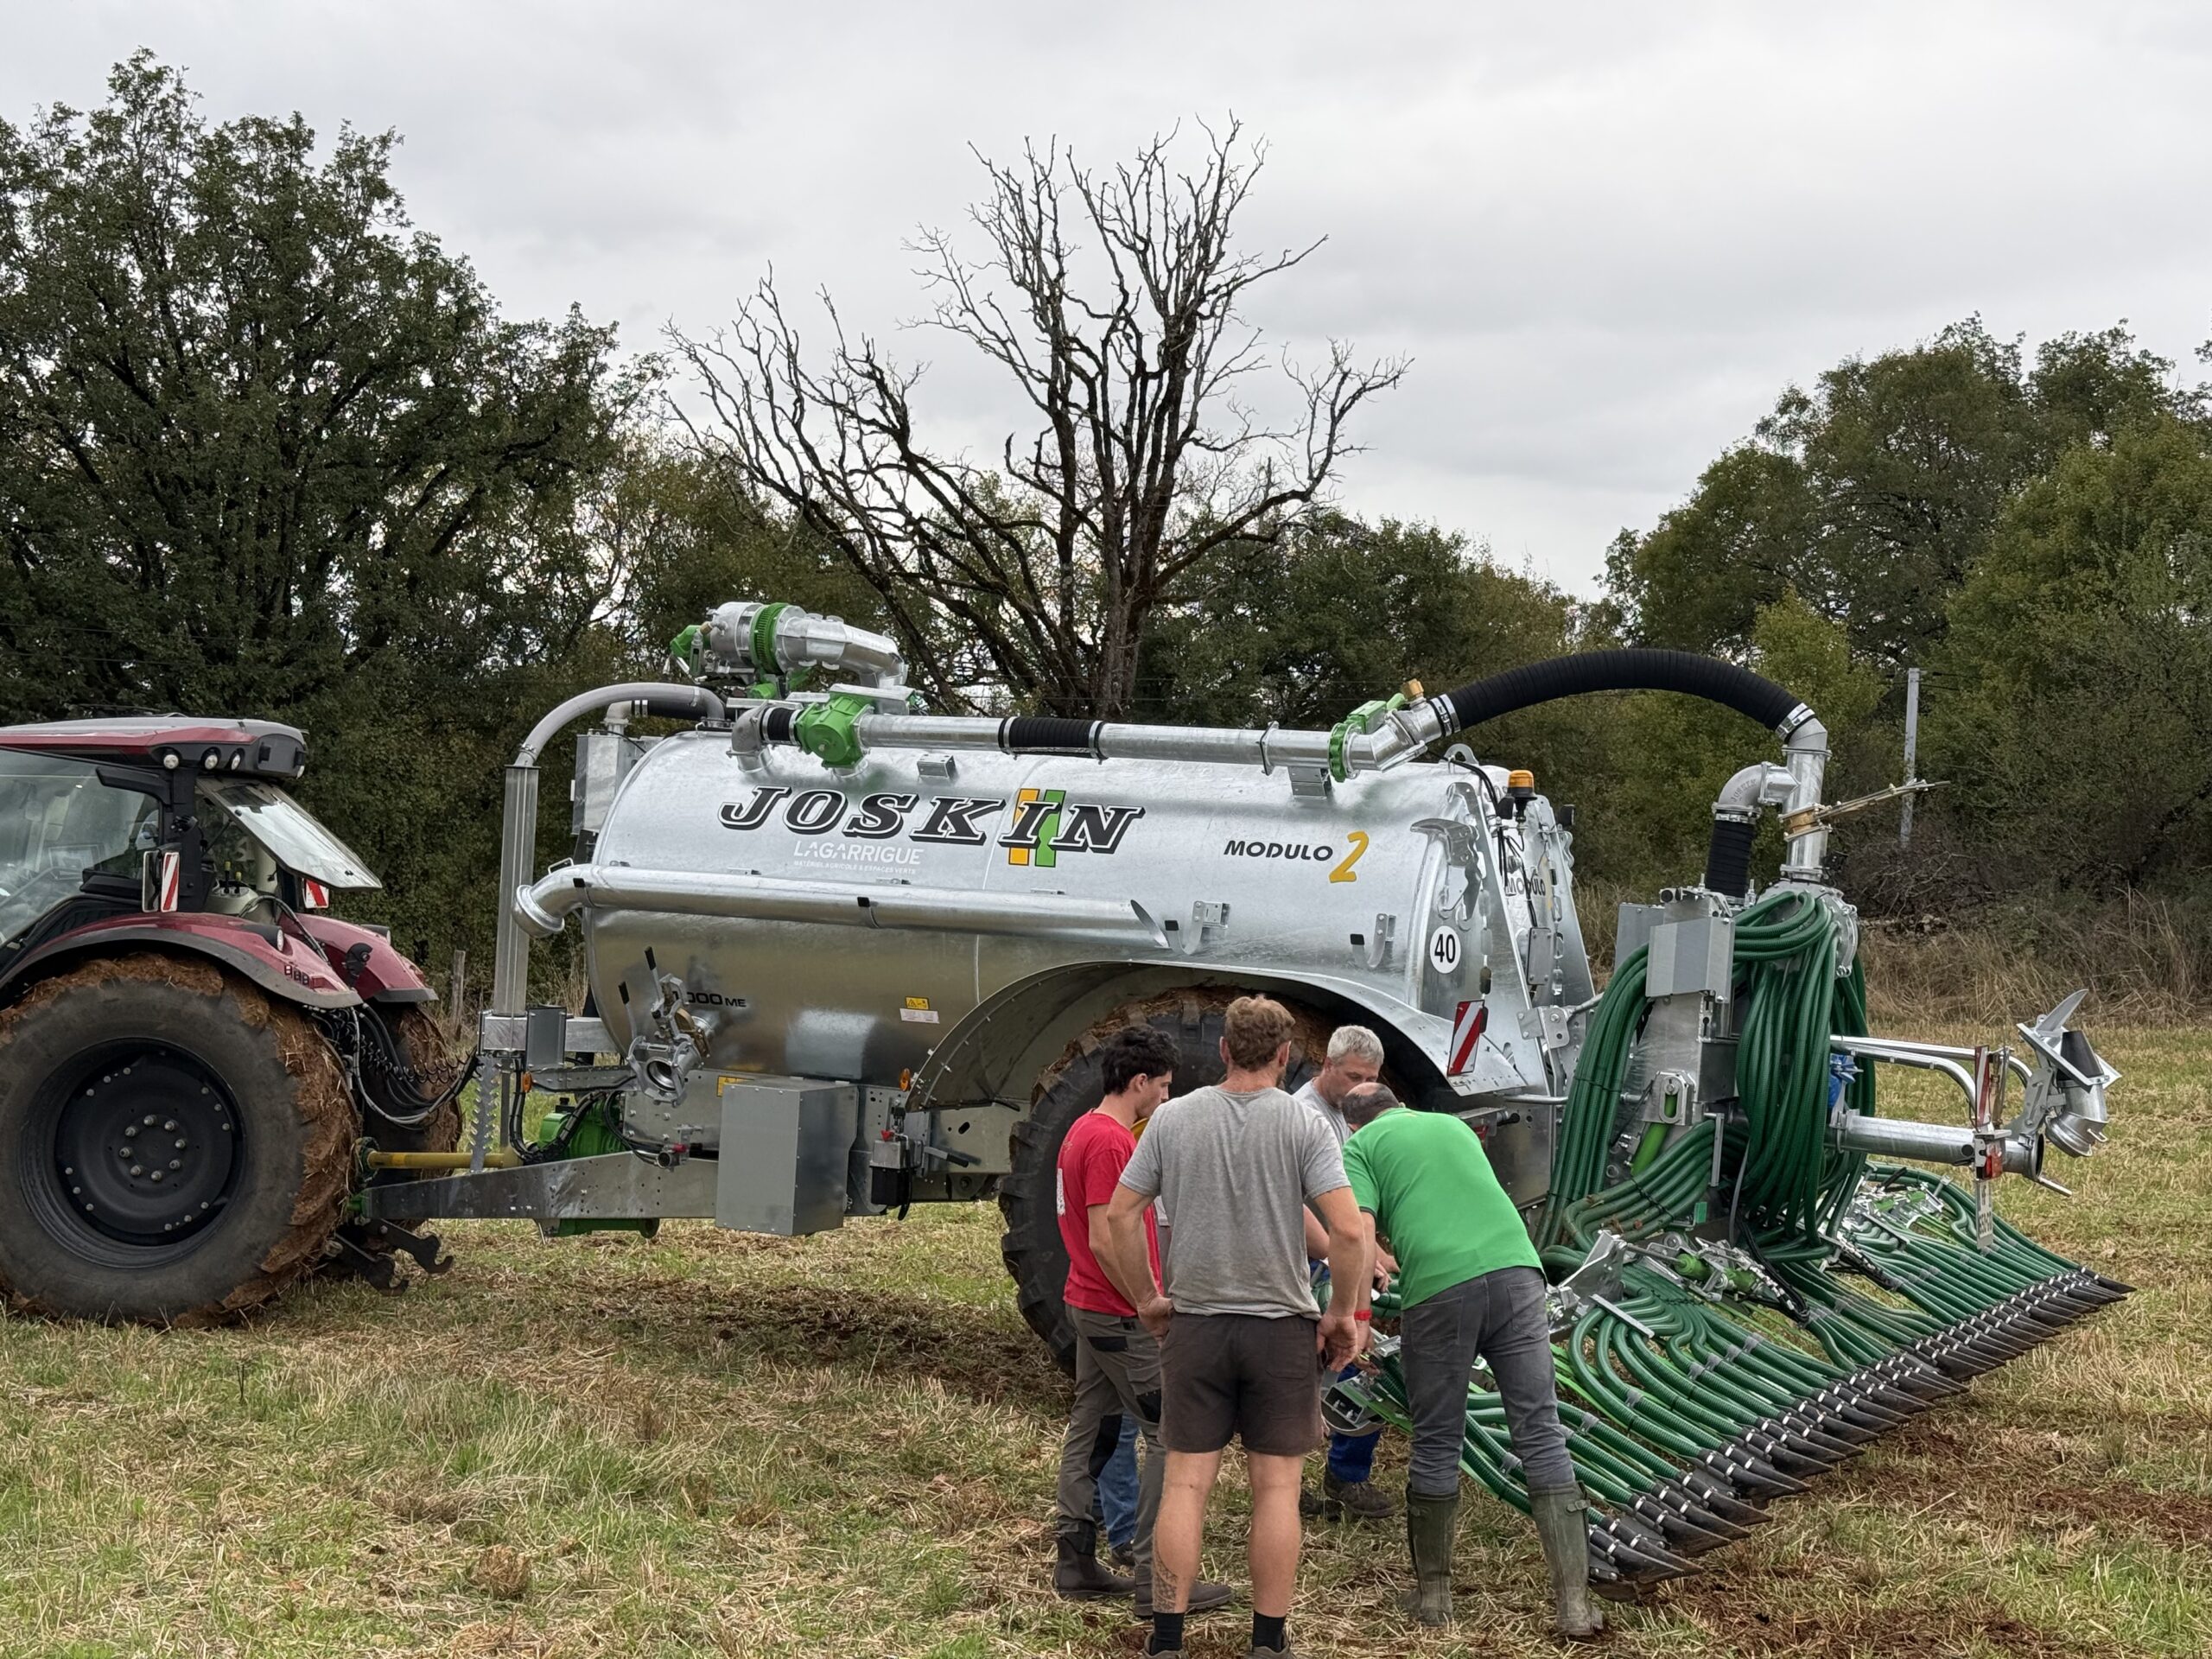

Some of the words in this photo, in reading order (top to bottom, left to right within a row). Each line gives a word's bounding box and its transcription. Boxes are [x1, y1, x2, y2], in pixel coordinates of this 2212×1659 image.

[719, 785, 1145, 854] JOSKIN
[793, 841, 925, 864] LAGARRIGUE
[1224, 840, 1333, 861] MODULO
[1329, 830, 1370, 883] 2
[1433, 933, 1457, 964] 40
[724, 997, 747, 1007] ME
